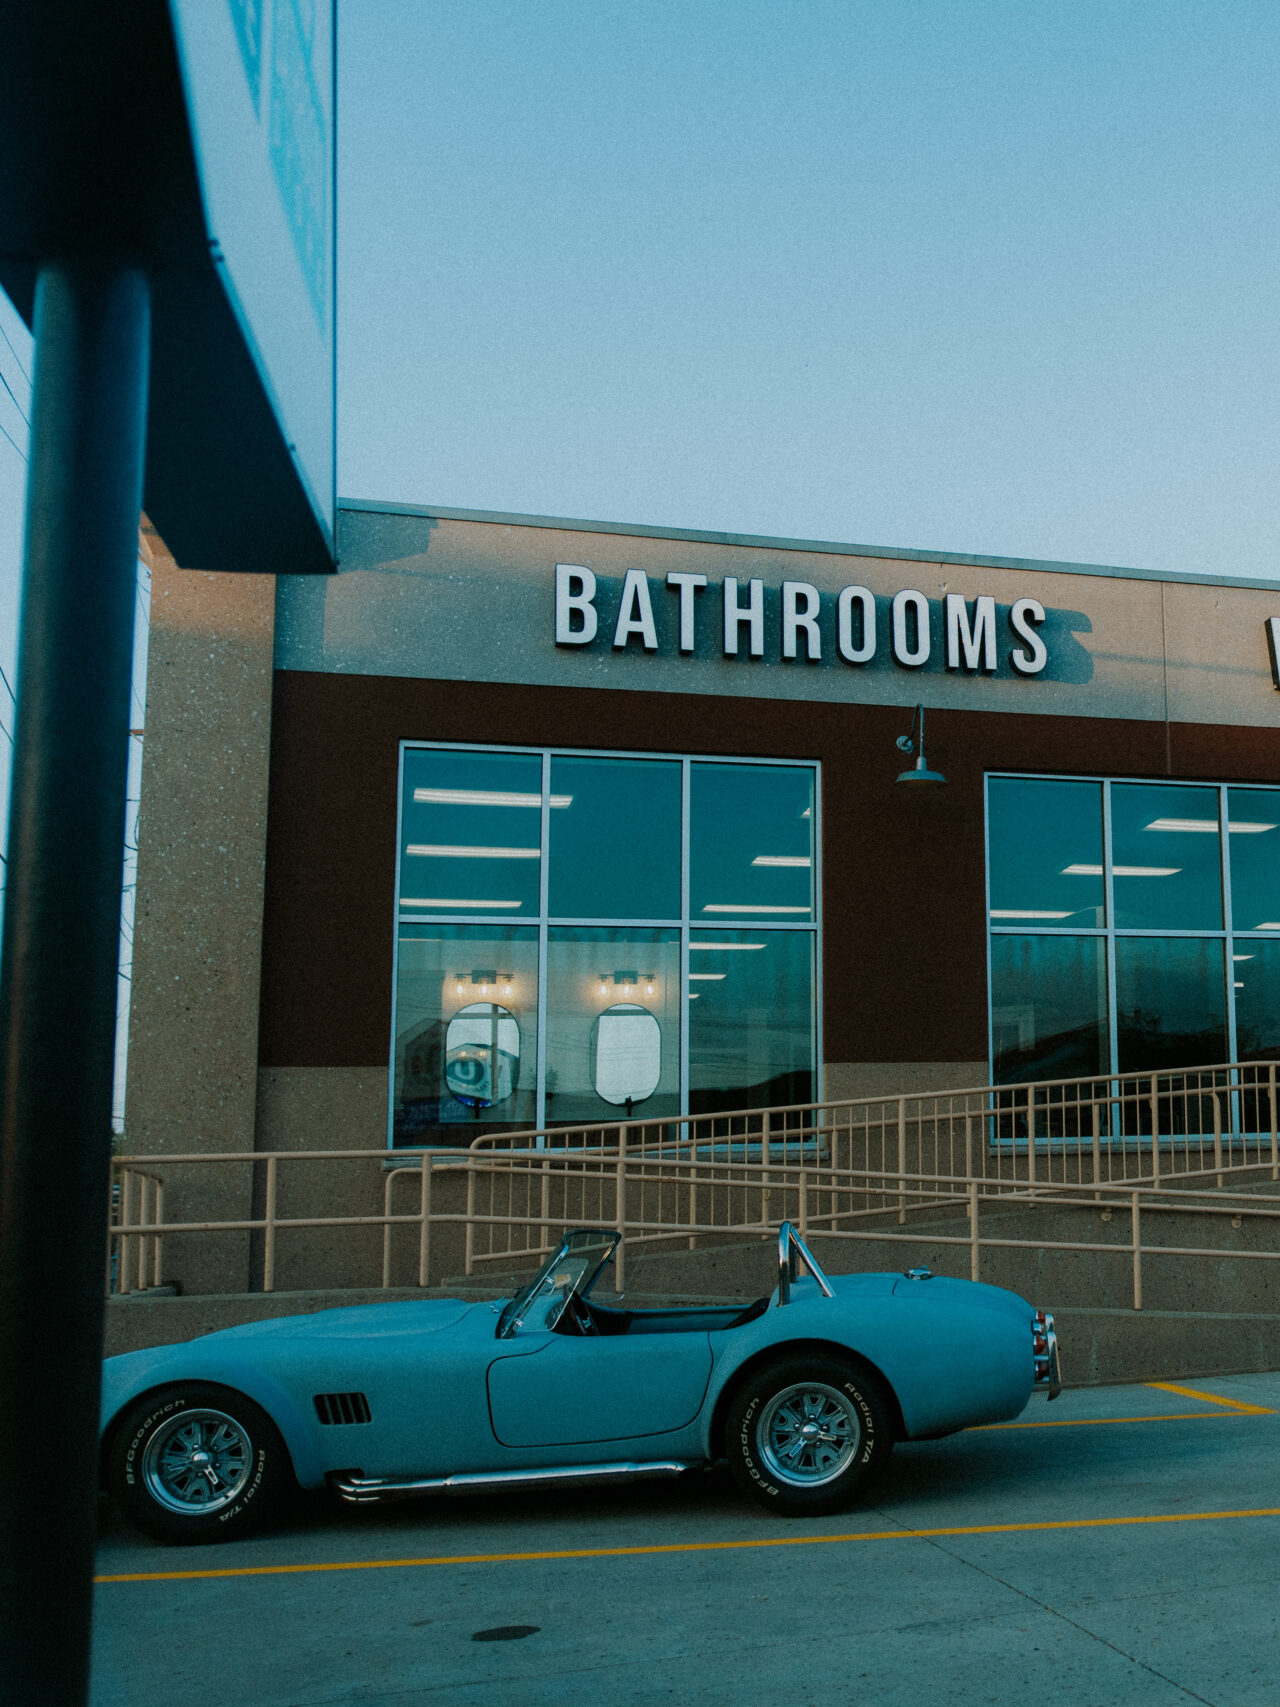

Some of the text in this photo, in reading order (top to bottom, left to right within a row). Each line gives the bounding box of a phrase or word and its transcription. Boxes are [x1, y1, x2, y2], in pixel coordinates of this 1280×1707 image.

[554, 562, 1048, 676] BATHROOMS
[126, 1399, 186, 1485] BFGoodrich
[740, 1397, 780, 1496] BFGoodrich
[844, 1382, 875, 1464] Radial T/A
[219, 1450, 266, 1522] Radial T/A
